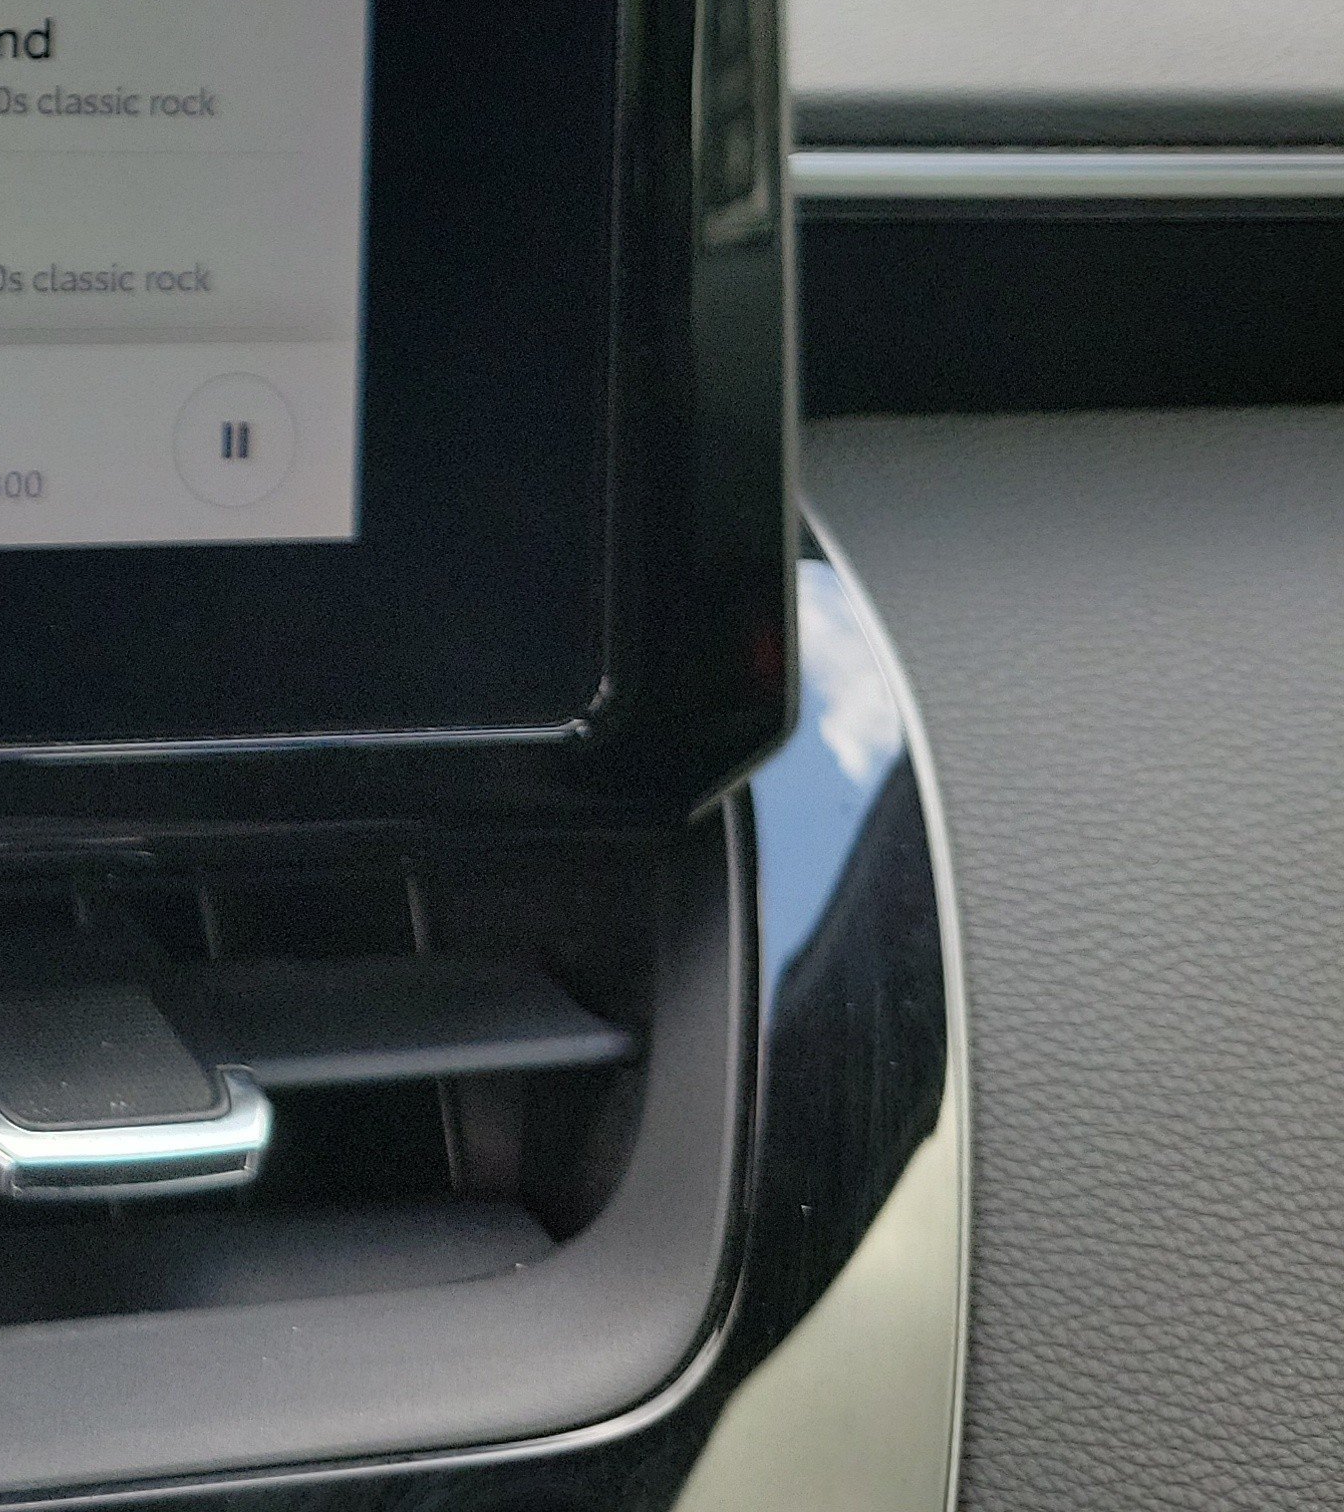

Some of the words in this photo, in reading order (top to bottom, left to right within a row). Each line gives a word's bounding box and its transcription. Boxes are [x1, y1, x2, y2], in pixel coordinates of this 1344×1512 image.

[36, 85, 141, 118] classic
[149, 87, 216, 118] rock
[32, 263, 135, 295] classic
[144, 262, 212, 295] rock
